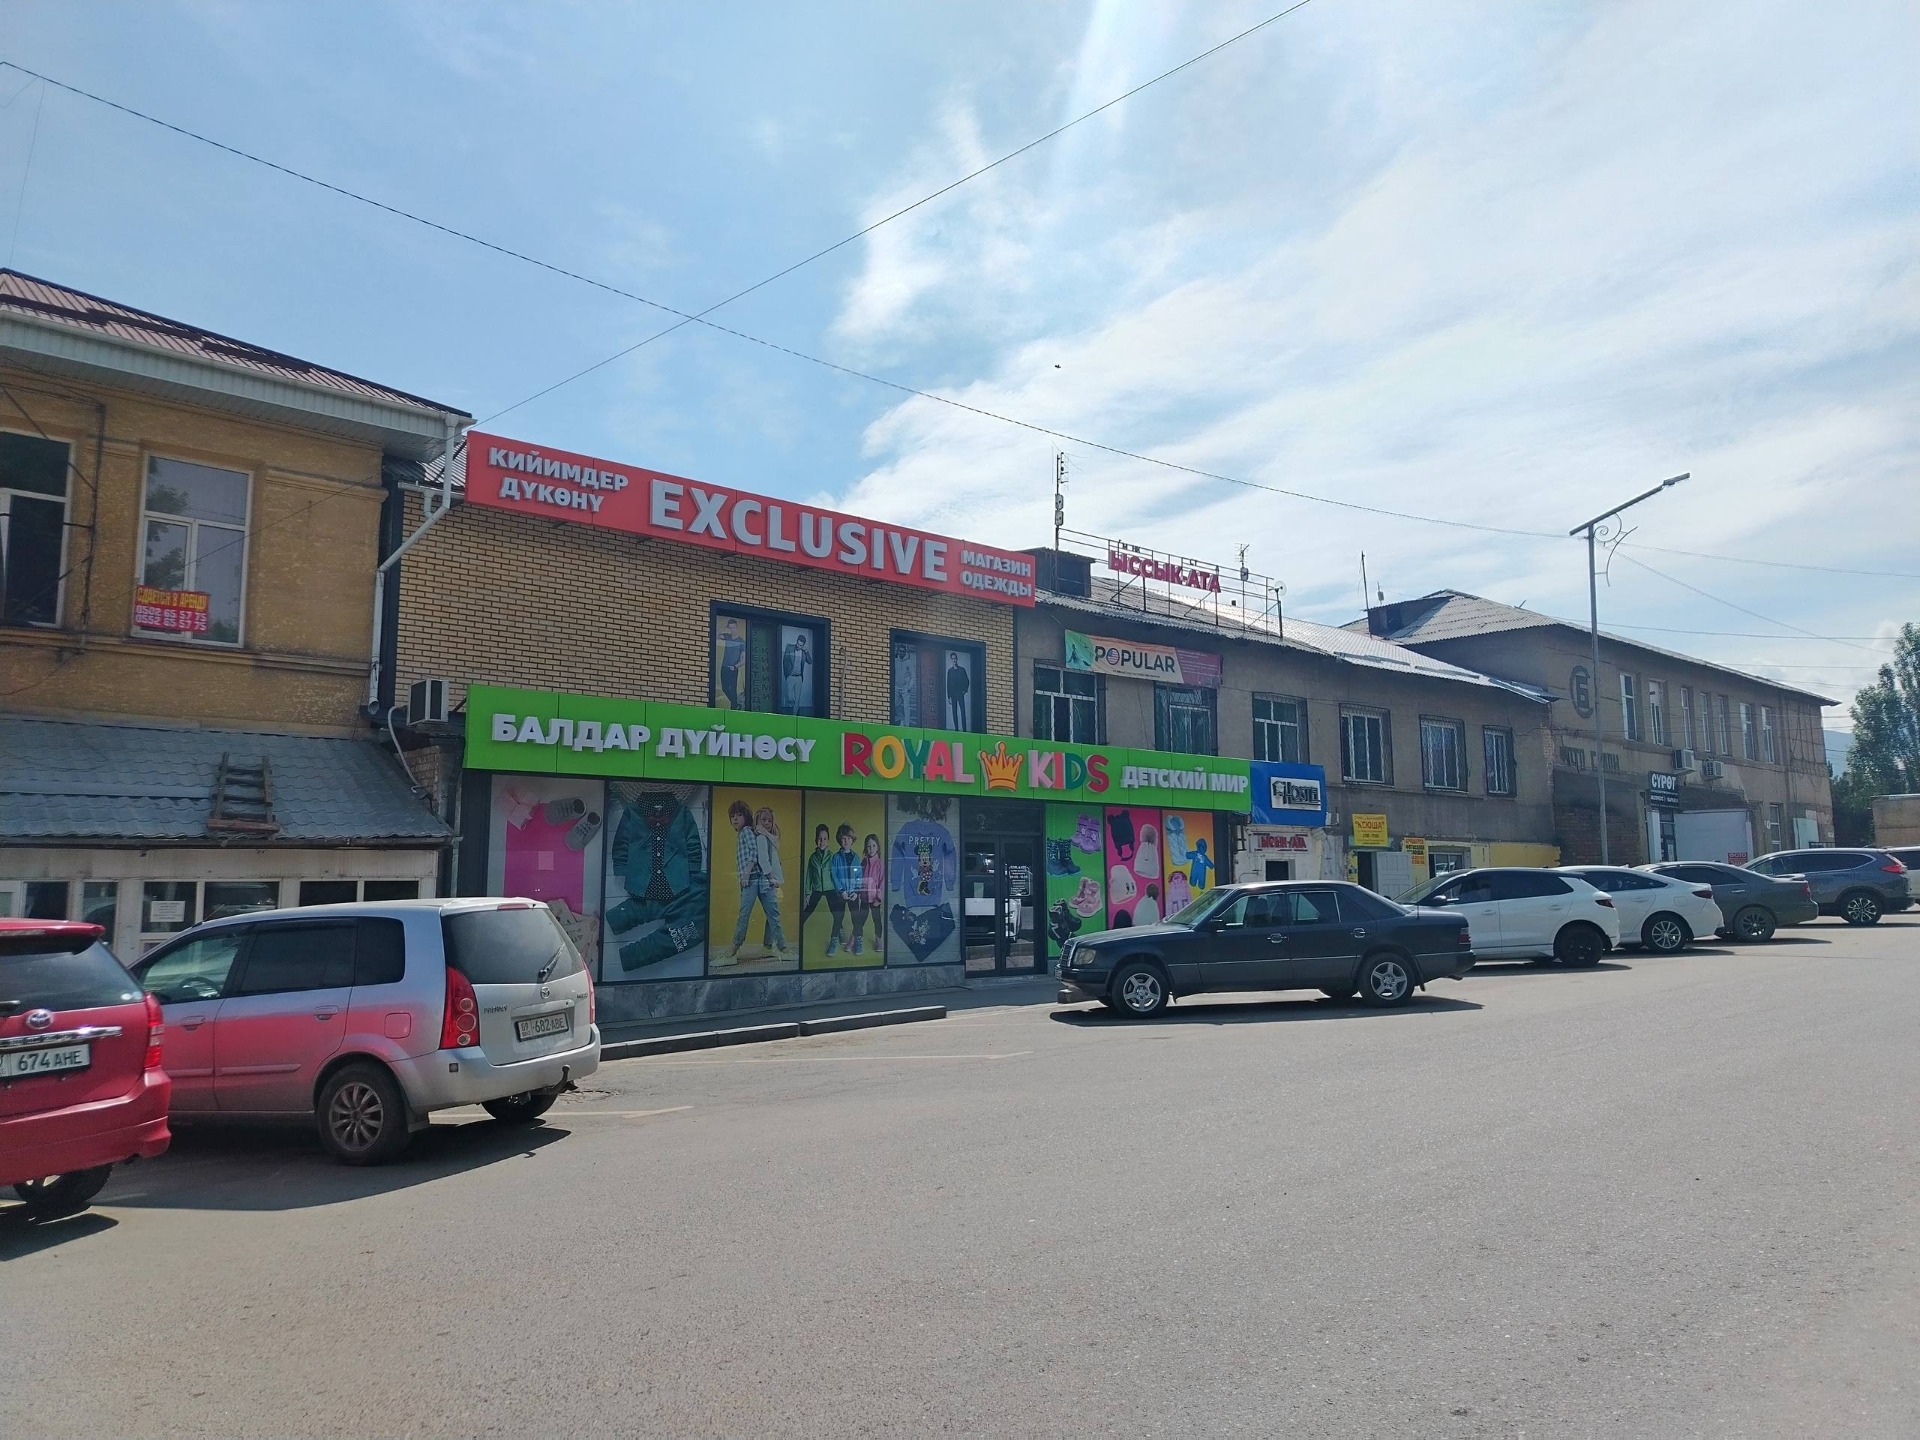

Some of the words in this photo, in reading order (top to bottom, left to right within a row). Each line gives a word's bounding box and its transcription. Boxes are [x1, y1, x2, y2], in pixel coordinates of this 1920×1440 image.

[488, 446, 629, 491] КИЙИМДЕР
[499, 477, 604, 513] ДҮКӨНҮ
[650, 478, 948, 582] EXCLUSIVE
[961, 550, 1031, 577] МАГАЗИН
[1108, 550, 1221, 593] ЫССЫК-АТА
[137, 588, 170, 606] СДАЕТСЯ
[172, 592, 178, 606] В
[960, 571, 1031, 597] ОДЕЖДЫ
[135, 614, 161, 625] 0552
[178, 620, 192, 629] 57
[136, 605, 161, 616] 0502
[179, 611, 192, 620] 57
[1094, 646, 1175, 673] POPULAR
[492, 713, 650, 753] БАЛДАР
[656, 724, 816, 762] ДҮЙНӨСҮ
[841, 732, 974, 784] ROYAL
[1028, 749, 1109, 793] KIDS
[1120, 764, 1209, 790] ДЕТСКИЙ
[1211, 774, 1249, 793] МИР
[534, 1019, 551, 1033] 682
[551, 1017, 565, 1030] ABE
[18, 1052, 50, 1072] 674
[53, 1050, 83, 1067] AHE
